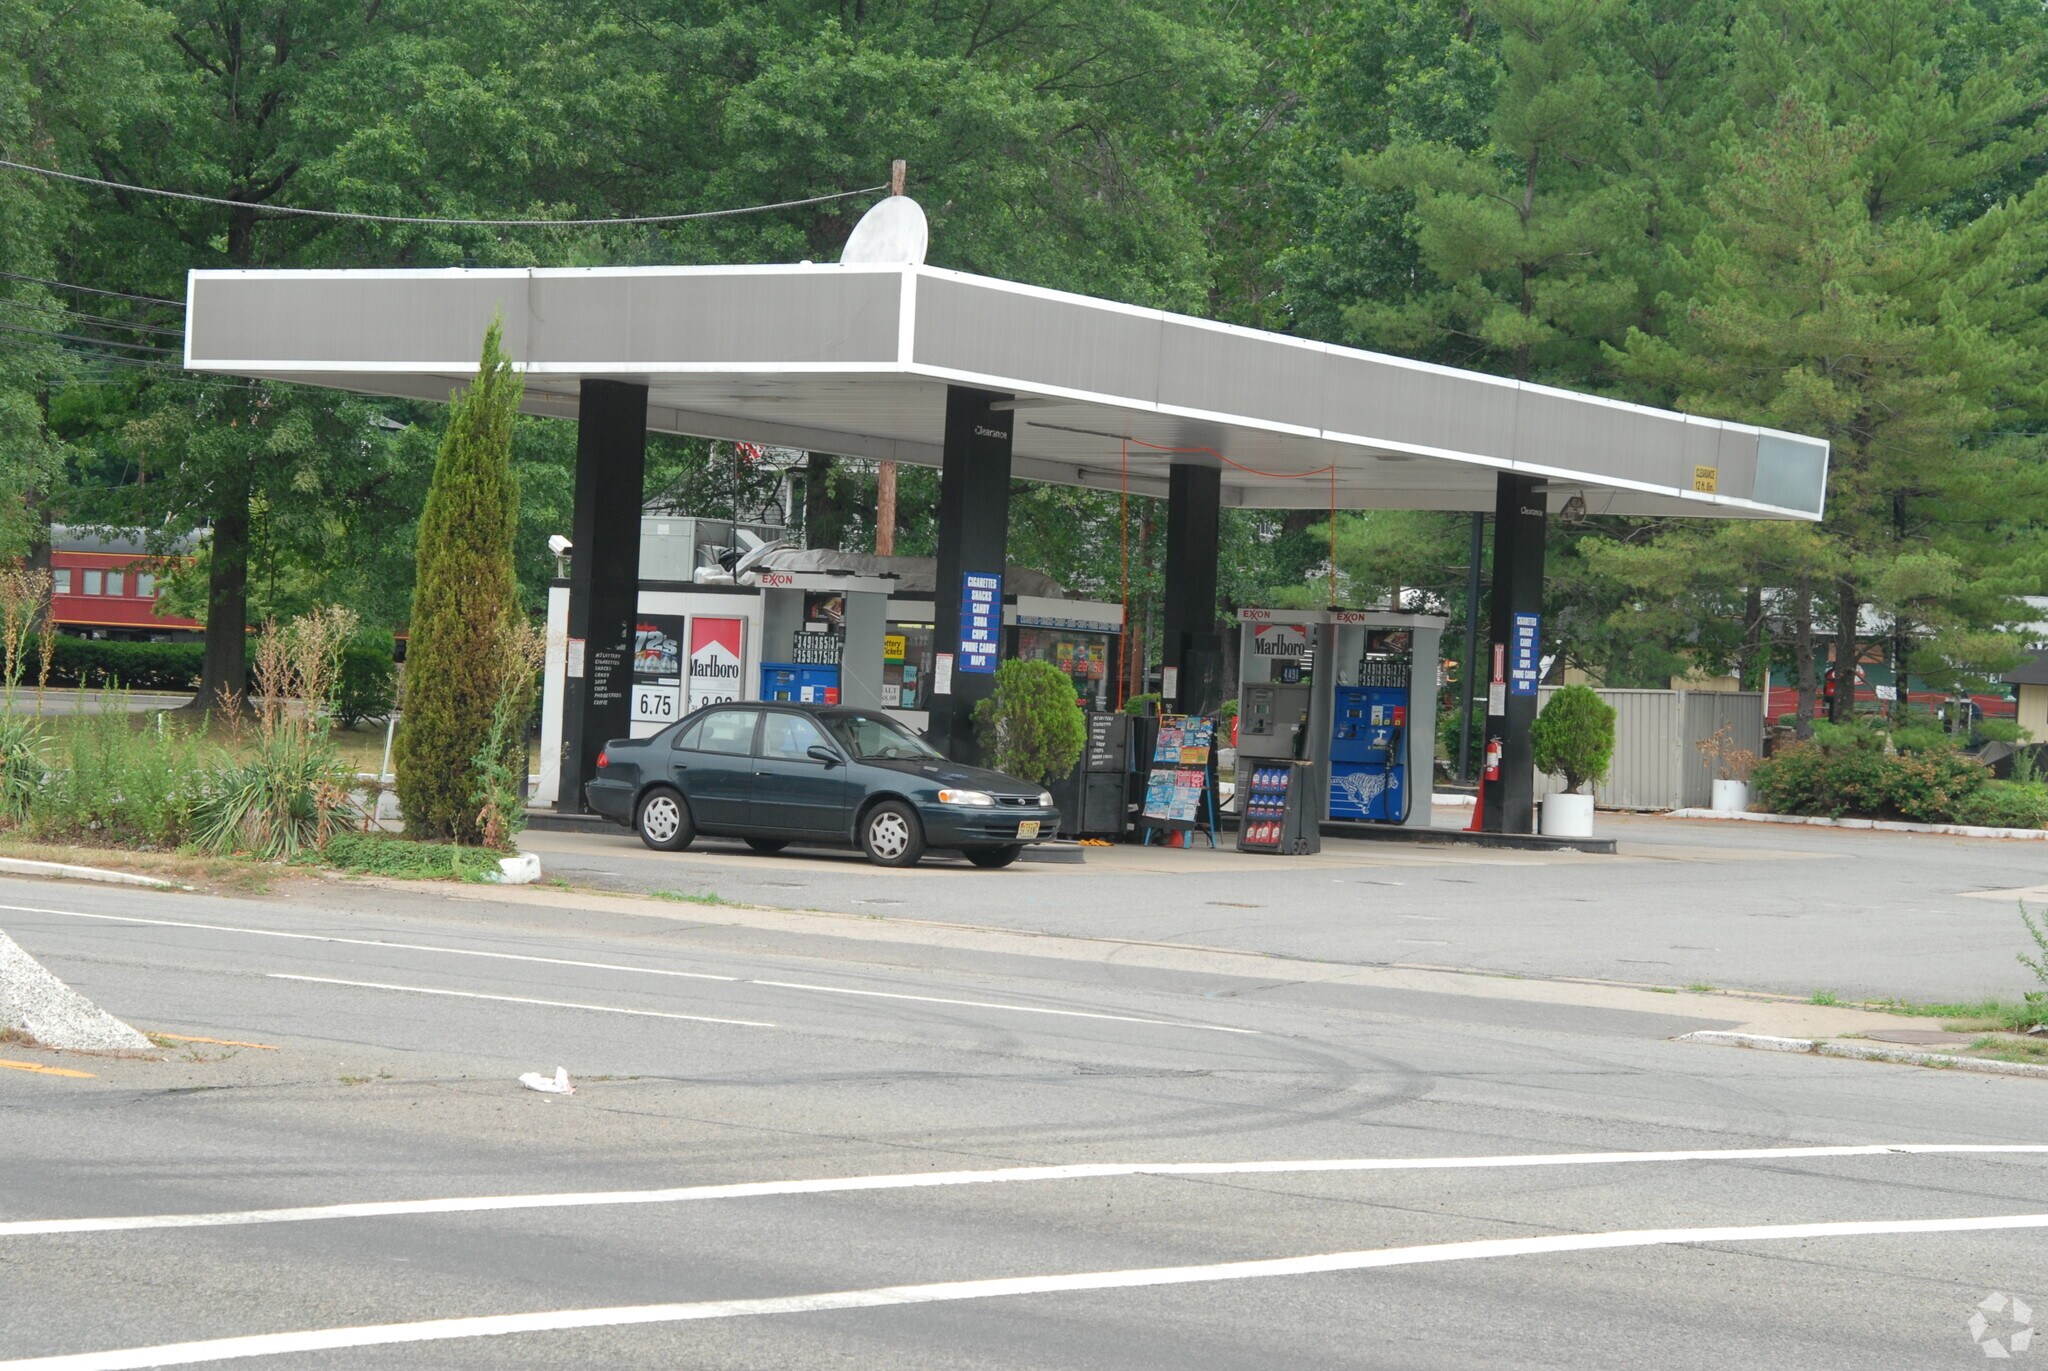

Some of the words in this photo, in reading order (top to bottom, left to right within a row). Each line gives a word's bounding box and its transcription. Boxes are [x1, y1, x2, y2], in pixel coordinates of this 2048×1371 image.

[762, 574, 792, 587] EXXON
[968, 577, 997, 589] CIGARETTES
[972, 590, 992, 601] SNACKS
[973, 603, 990, 614] CANDY
[1243, 610, 1270, 620] EXXON
[1337, 612, 1365, 623] EXXON
[974, 616, 987, 627] SODA
[972, 629, 988, 640] CHIPS
[962, 641, 978, 652] PHONE
[1254, 634, 1305, 655] Marlboro
[971, 655, 986, 666] MAPS
[640, 694, 671, 716] 6.75
